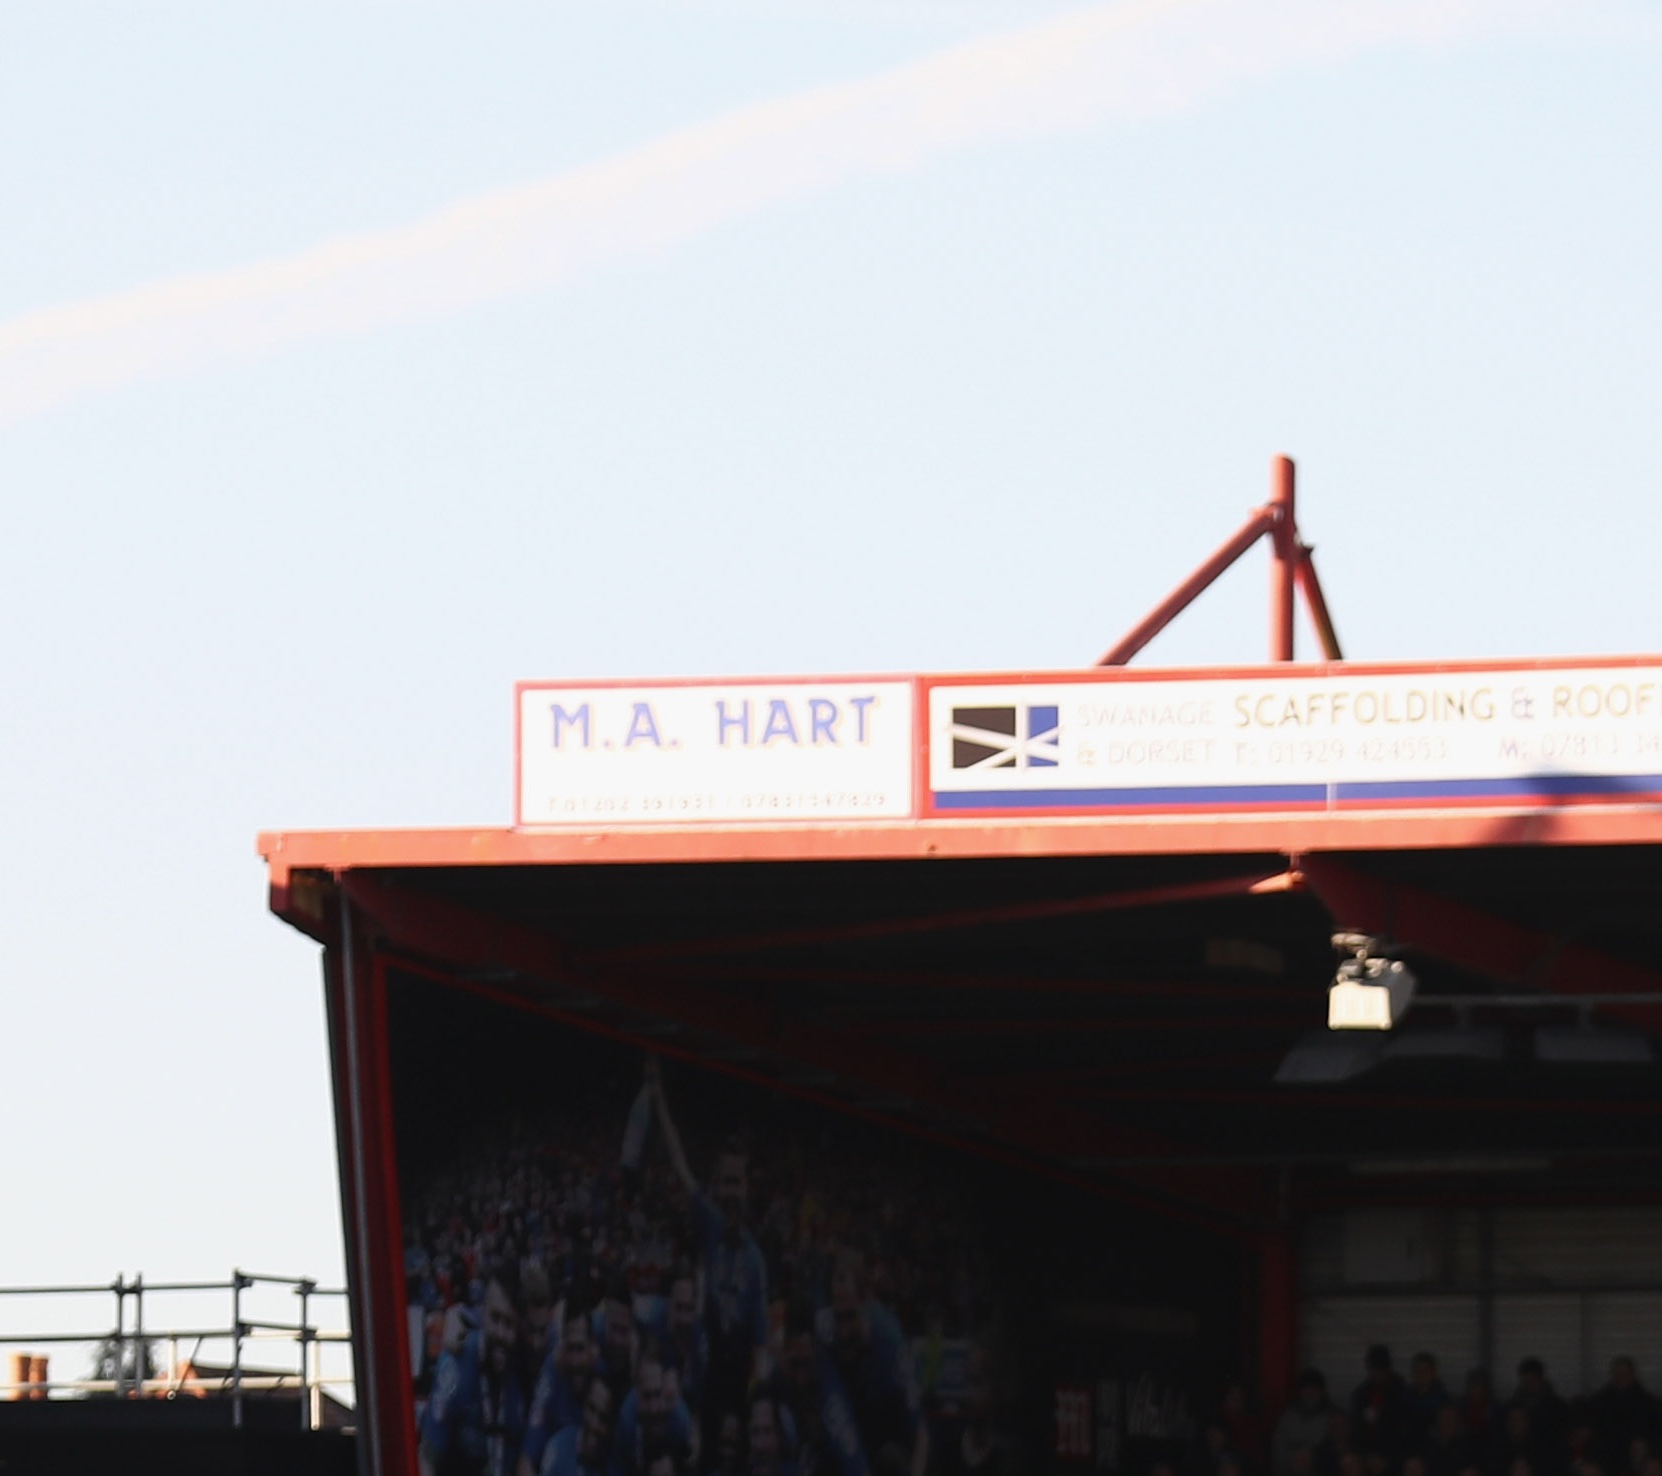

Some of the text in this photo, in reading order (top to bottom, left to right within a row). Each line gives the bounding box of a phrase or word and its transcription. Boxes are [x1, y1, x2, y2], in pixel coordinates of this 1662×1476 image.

[549, 694, 877, 748] M.A. HART
[1234, 687, 1496, 728] SCAFFOLDING
[1510, 686, 1536, 720] &
[1107, 738, 1216, 766] DORSET
